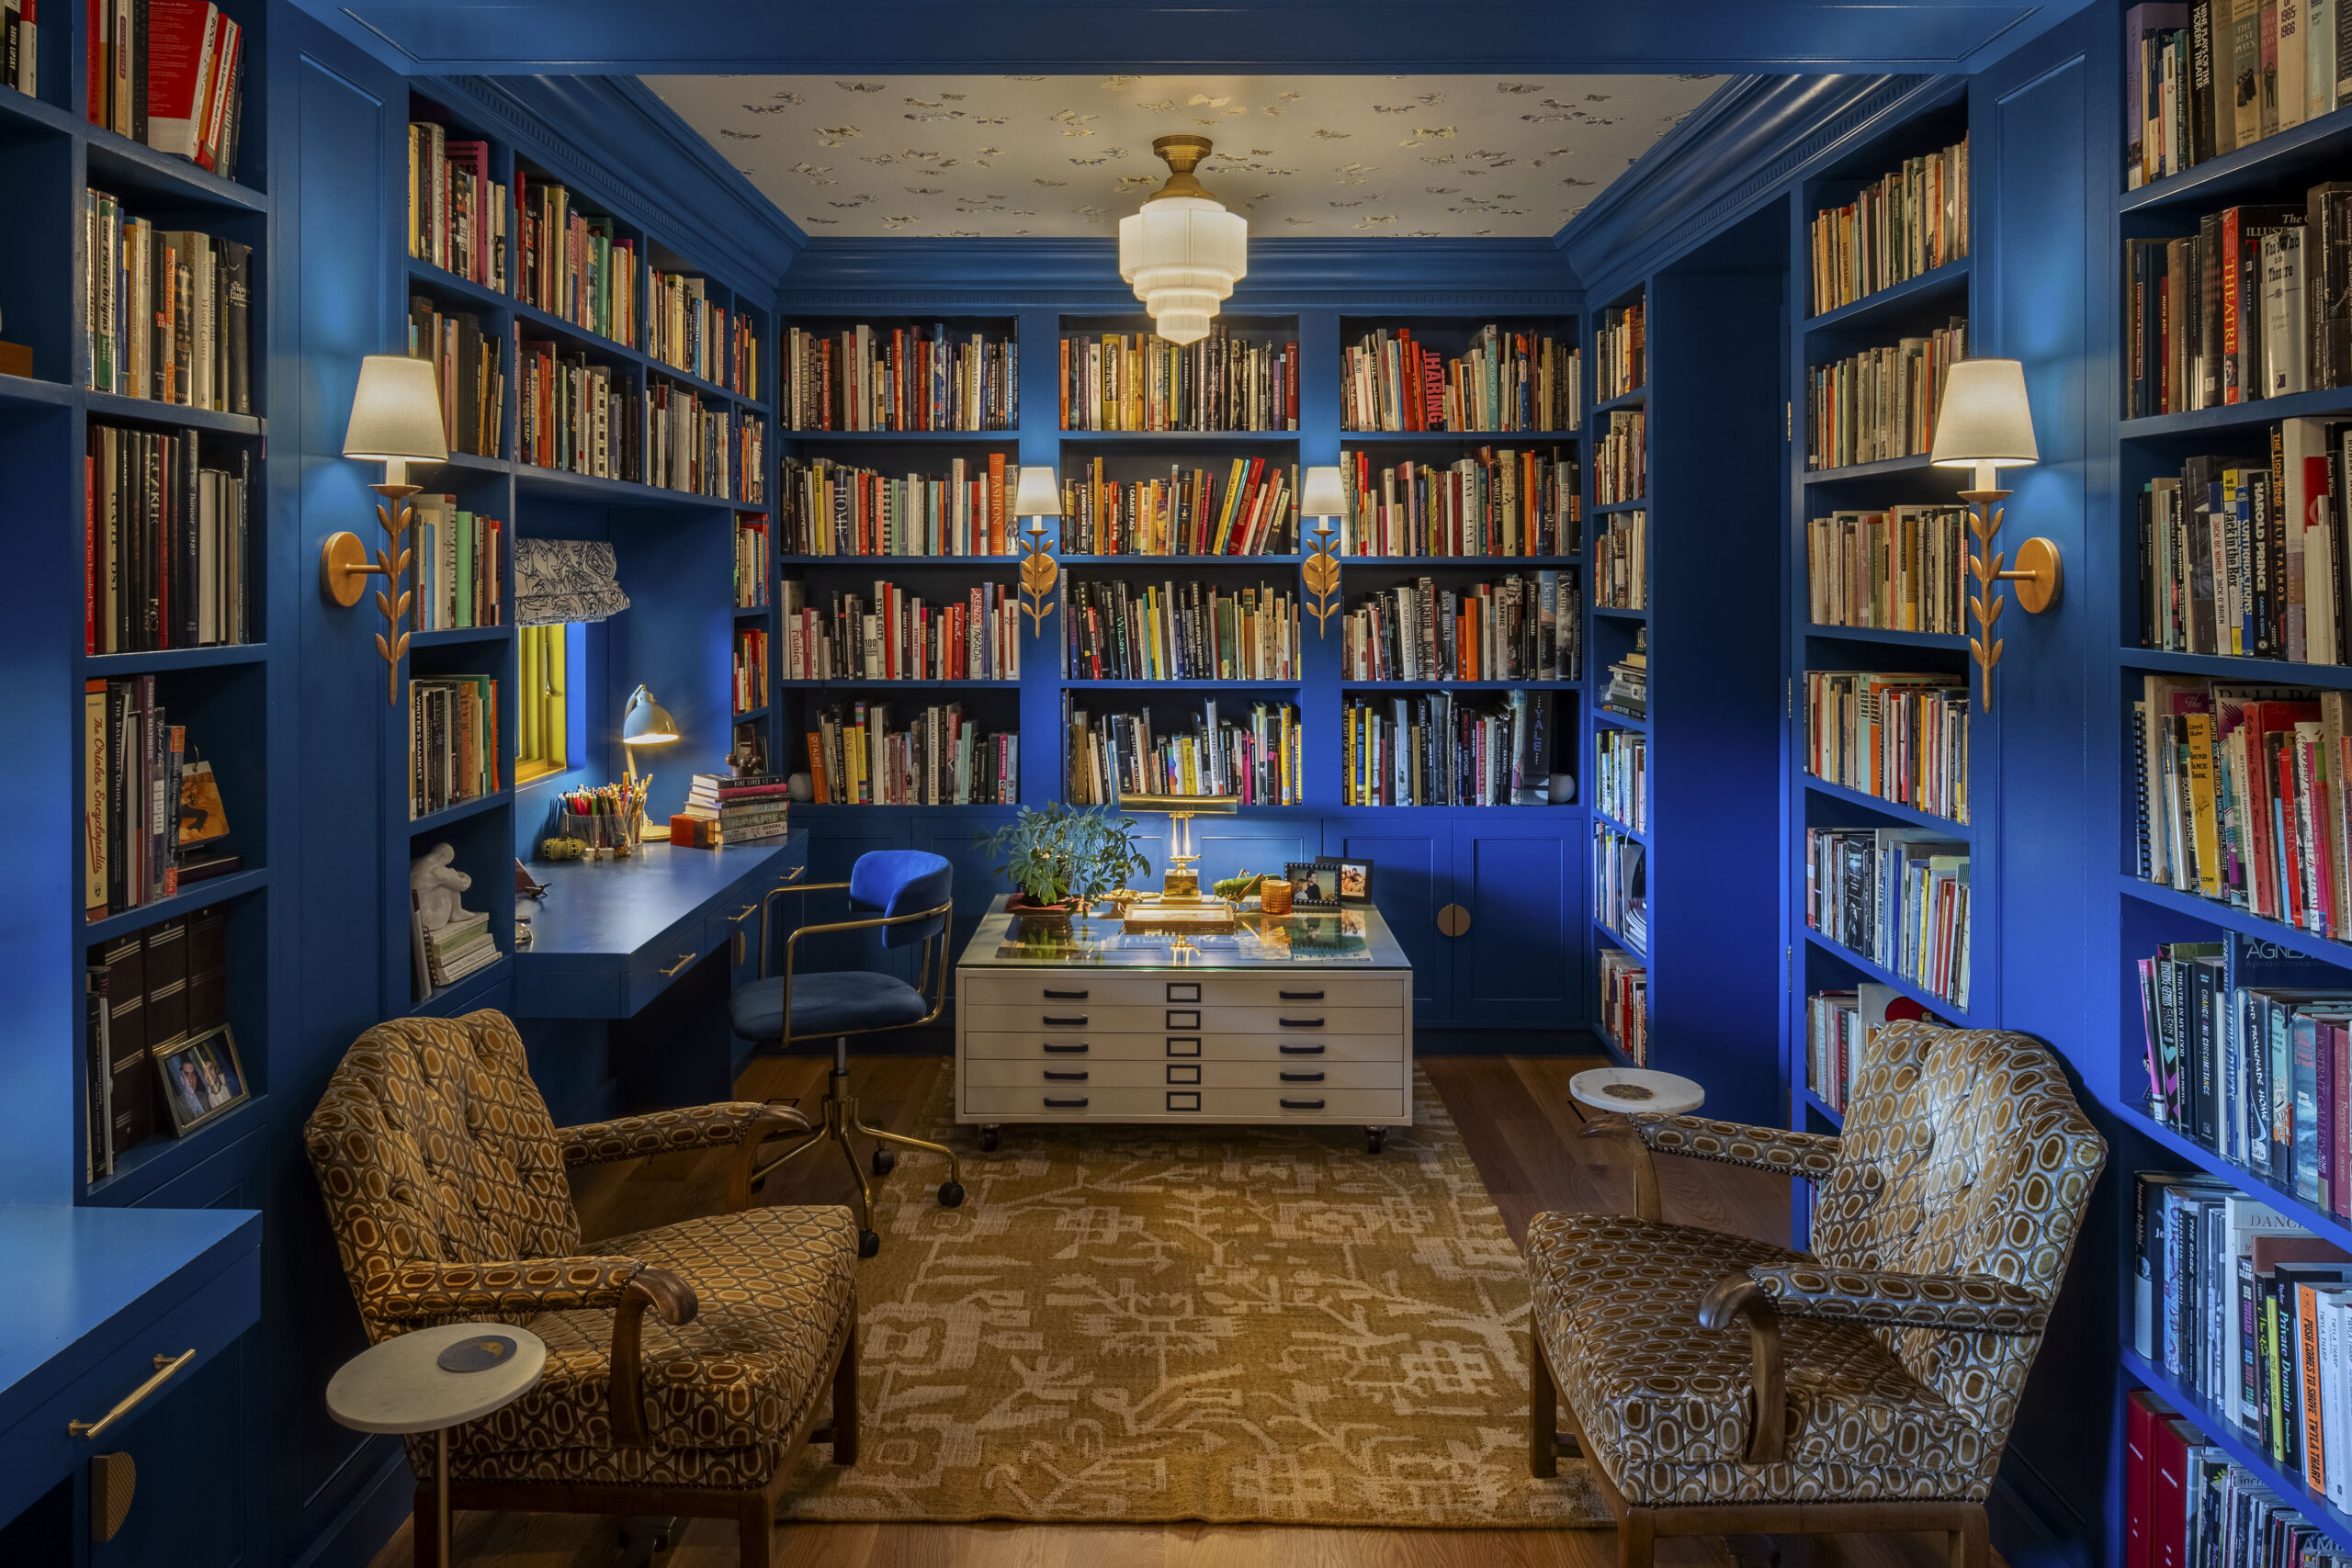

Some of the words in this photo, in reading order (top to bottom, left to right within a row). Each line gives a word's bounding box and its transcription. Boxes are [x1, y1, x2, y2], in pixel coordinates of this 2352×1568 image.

[208, 17, 216, 48] BOOK
[2193, 7, 2201, 48] MODERN
[2280, 22, 2295, 39] 1966
[2202, 56, 2209, 67] OF
[2282, 214, 2301, 224] The
[102, 245, 110, 286] Phrase
[102, 288, 110, 331] Origins
[2224, 260, 2235, 352] THEATRE
[1426, 358, 1442, 423] HARING
[2273, 434, 2281, 450] THE
[2273, 454, 2283, 479] LION
[992, 476, 1001, 525] FASHION
[1561, 483, 1569, 491] U2
[2273, 481, 2283, 506] KING
[835, 487, 847, 536] HOME
[1561, 493, 1569, 512] SHOW
[1572, 495, 1580, 521] HIPPIE
[2255, 483, 2265, 539] HAROLD
[2225, 510, 2236, 535] Jack
[2214, 541, 2221, 549] BE
[2227, 536, 2236, 547] in
[2214, 551, 2222, 575] NIMBLE
[2228, 548, 2237, 566] the
[2256, 542, 2266, 591] PRINCE
[2229, 568, 2238, 586] Box
[1421, 580, 1430, 604] LINCOLN
[1544, 581, 1554, 612] Berlin
[1559, 581, 1569, 615] Vienna
[973, 593, 981, 625] KENZO
[1423, 606, 1431, 629] CENTER
[793, 629, 802, 665] Fashion
[973, 626, 982, 661] TAKADA
[1424, 641, 1433, 658] INSIDE
[1425, 660, 1433, 673] OUT
[94, 718, 102, 734] The
[94, 739, 105, 784] Orioles
[2182, 777, 2191, 811] SQUARE
[2216, 798, 2224, 821] DANCING
[93, 791, 105, 874] Encyclopedia
[2178, 1017, 2184, 1029] MY
[2252, 1025, 2263, 1085] PROMENADE
[2258, 1089, 2268, 1121] HOME
[2317, 1036, 2325, 1093] PORTRAIT
[2278, 1311, 2290, 1356] Private
[2304, 1318, 2313, 1341] PUSH
[2306, 1343, 2315, 1372] COMES
[2281, 1359, 2291, 1411] Domain
[2307, 1375, 2315, 1386] TO
[2307, 1388, 2317, 1414] SHOVE
[2308, 1419, 2319, 1450] TWYLA
[2310, 1451, 2321, 1483] THARP
